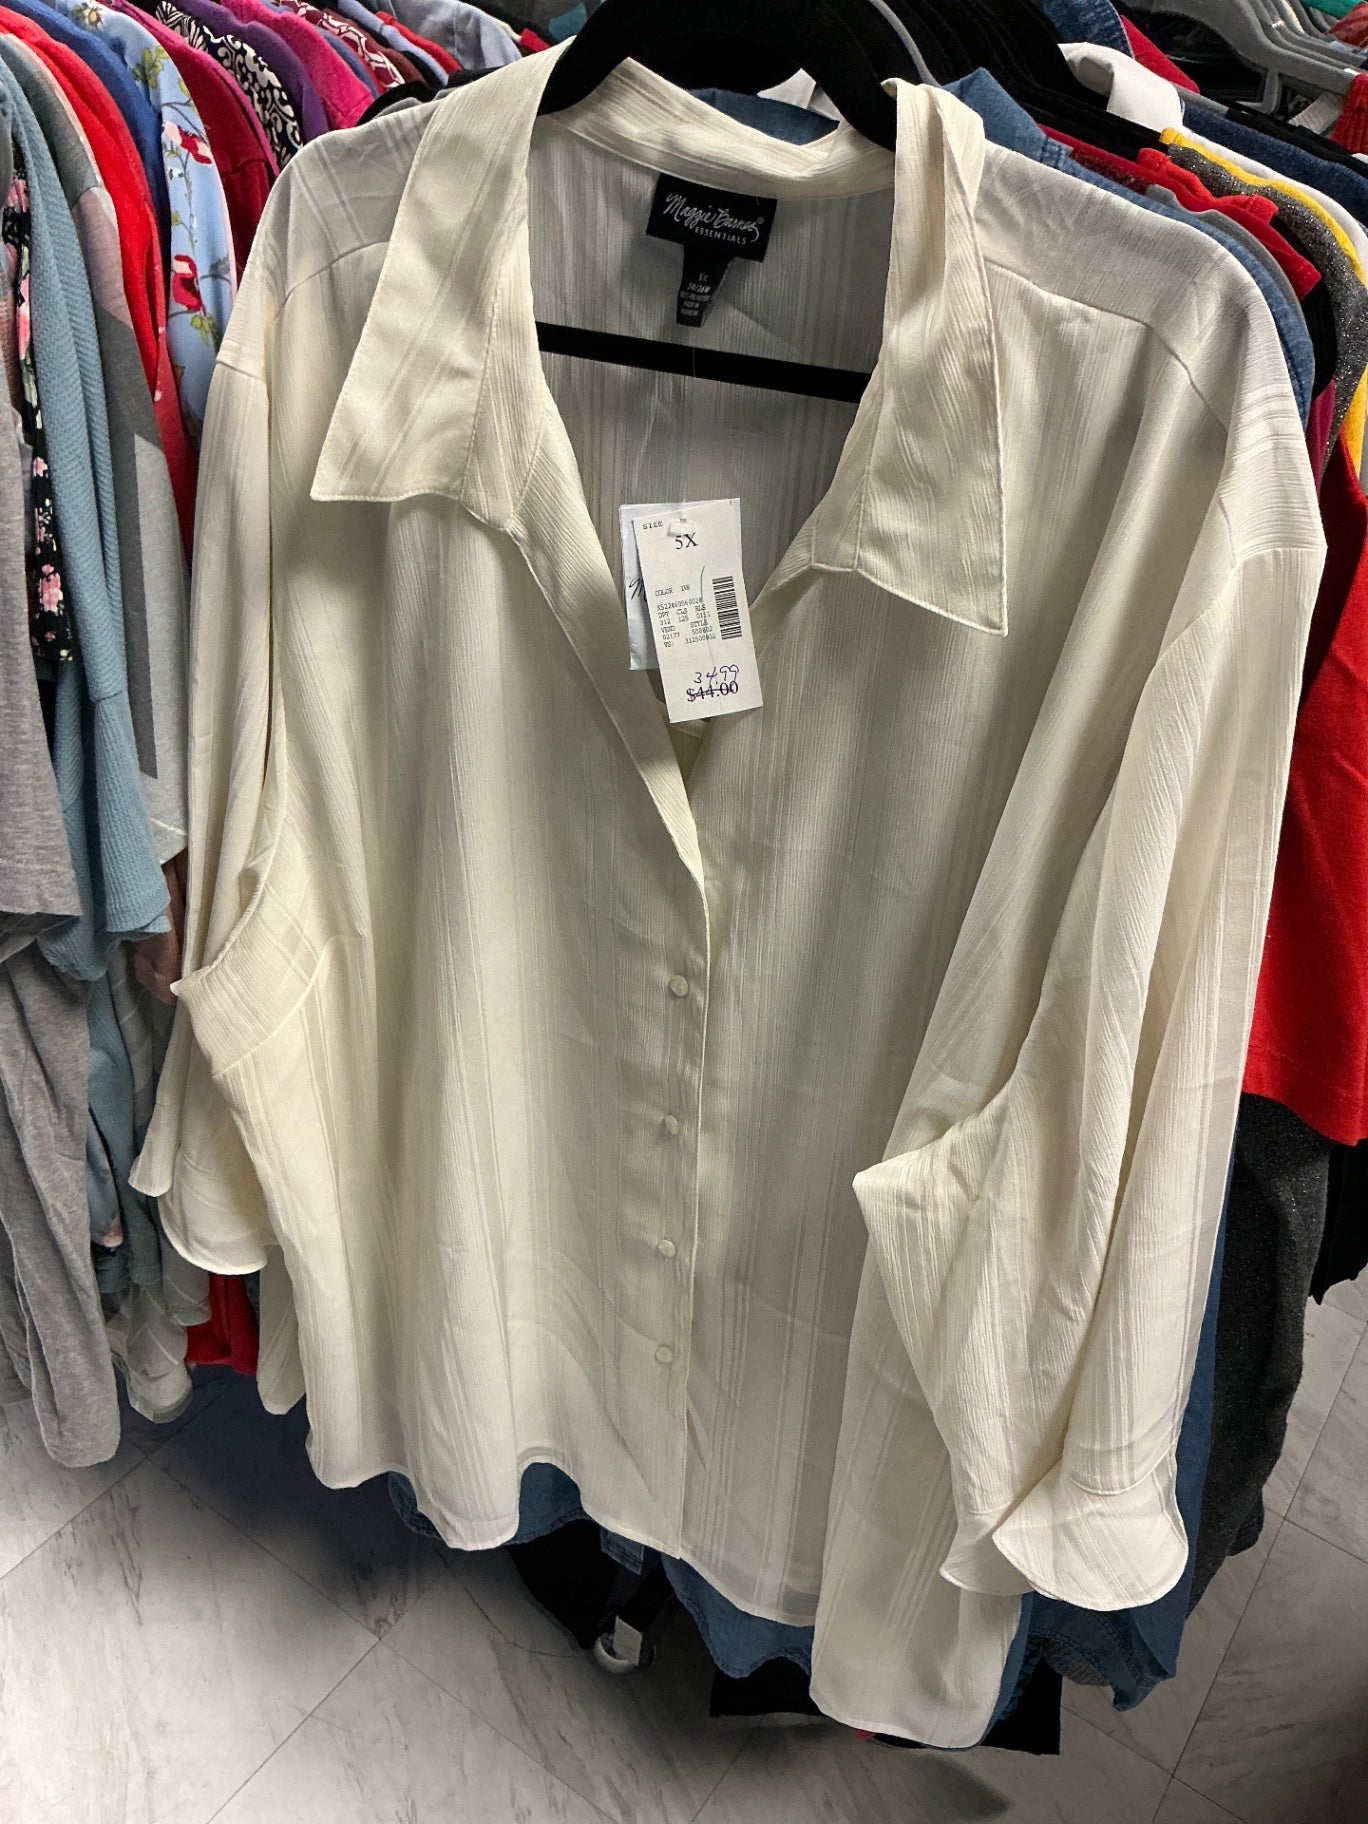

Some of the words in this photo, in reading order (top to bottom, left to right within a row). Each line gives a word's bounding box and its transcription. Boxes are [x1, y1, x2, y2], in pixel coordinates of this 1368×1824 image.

[694, 226, 746, 245] ESSENTIALS
[642, 520, 664, 530] SIZE
[675, 532, 698, 550] 5X
[655, 587, 673, 597] COLOR
